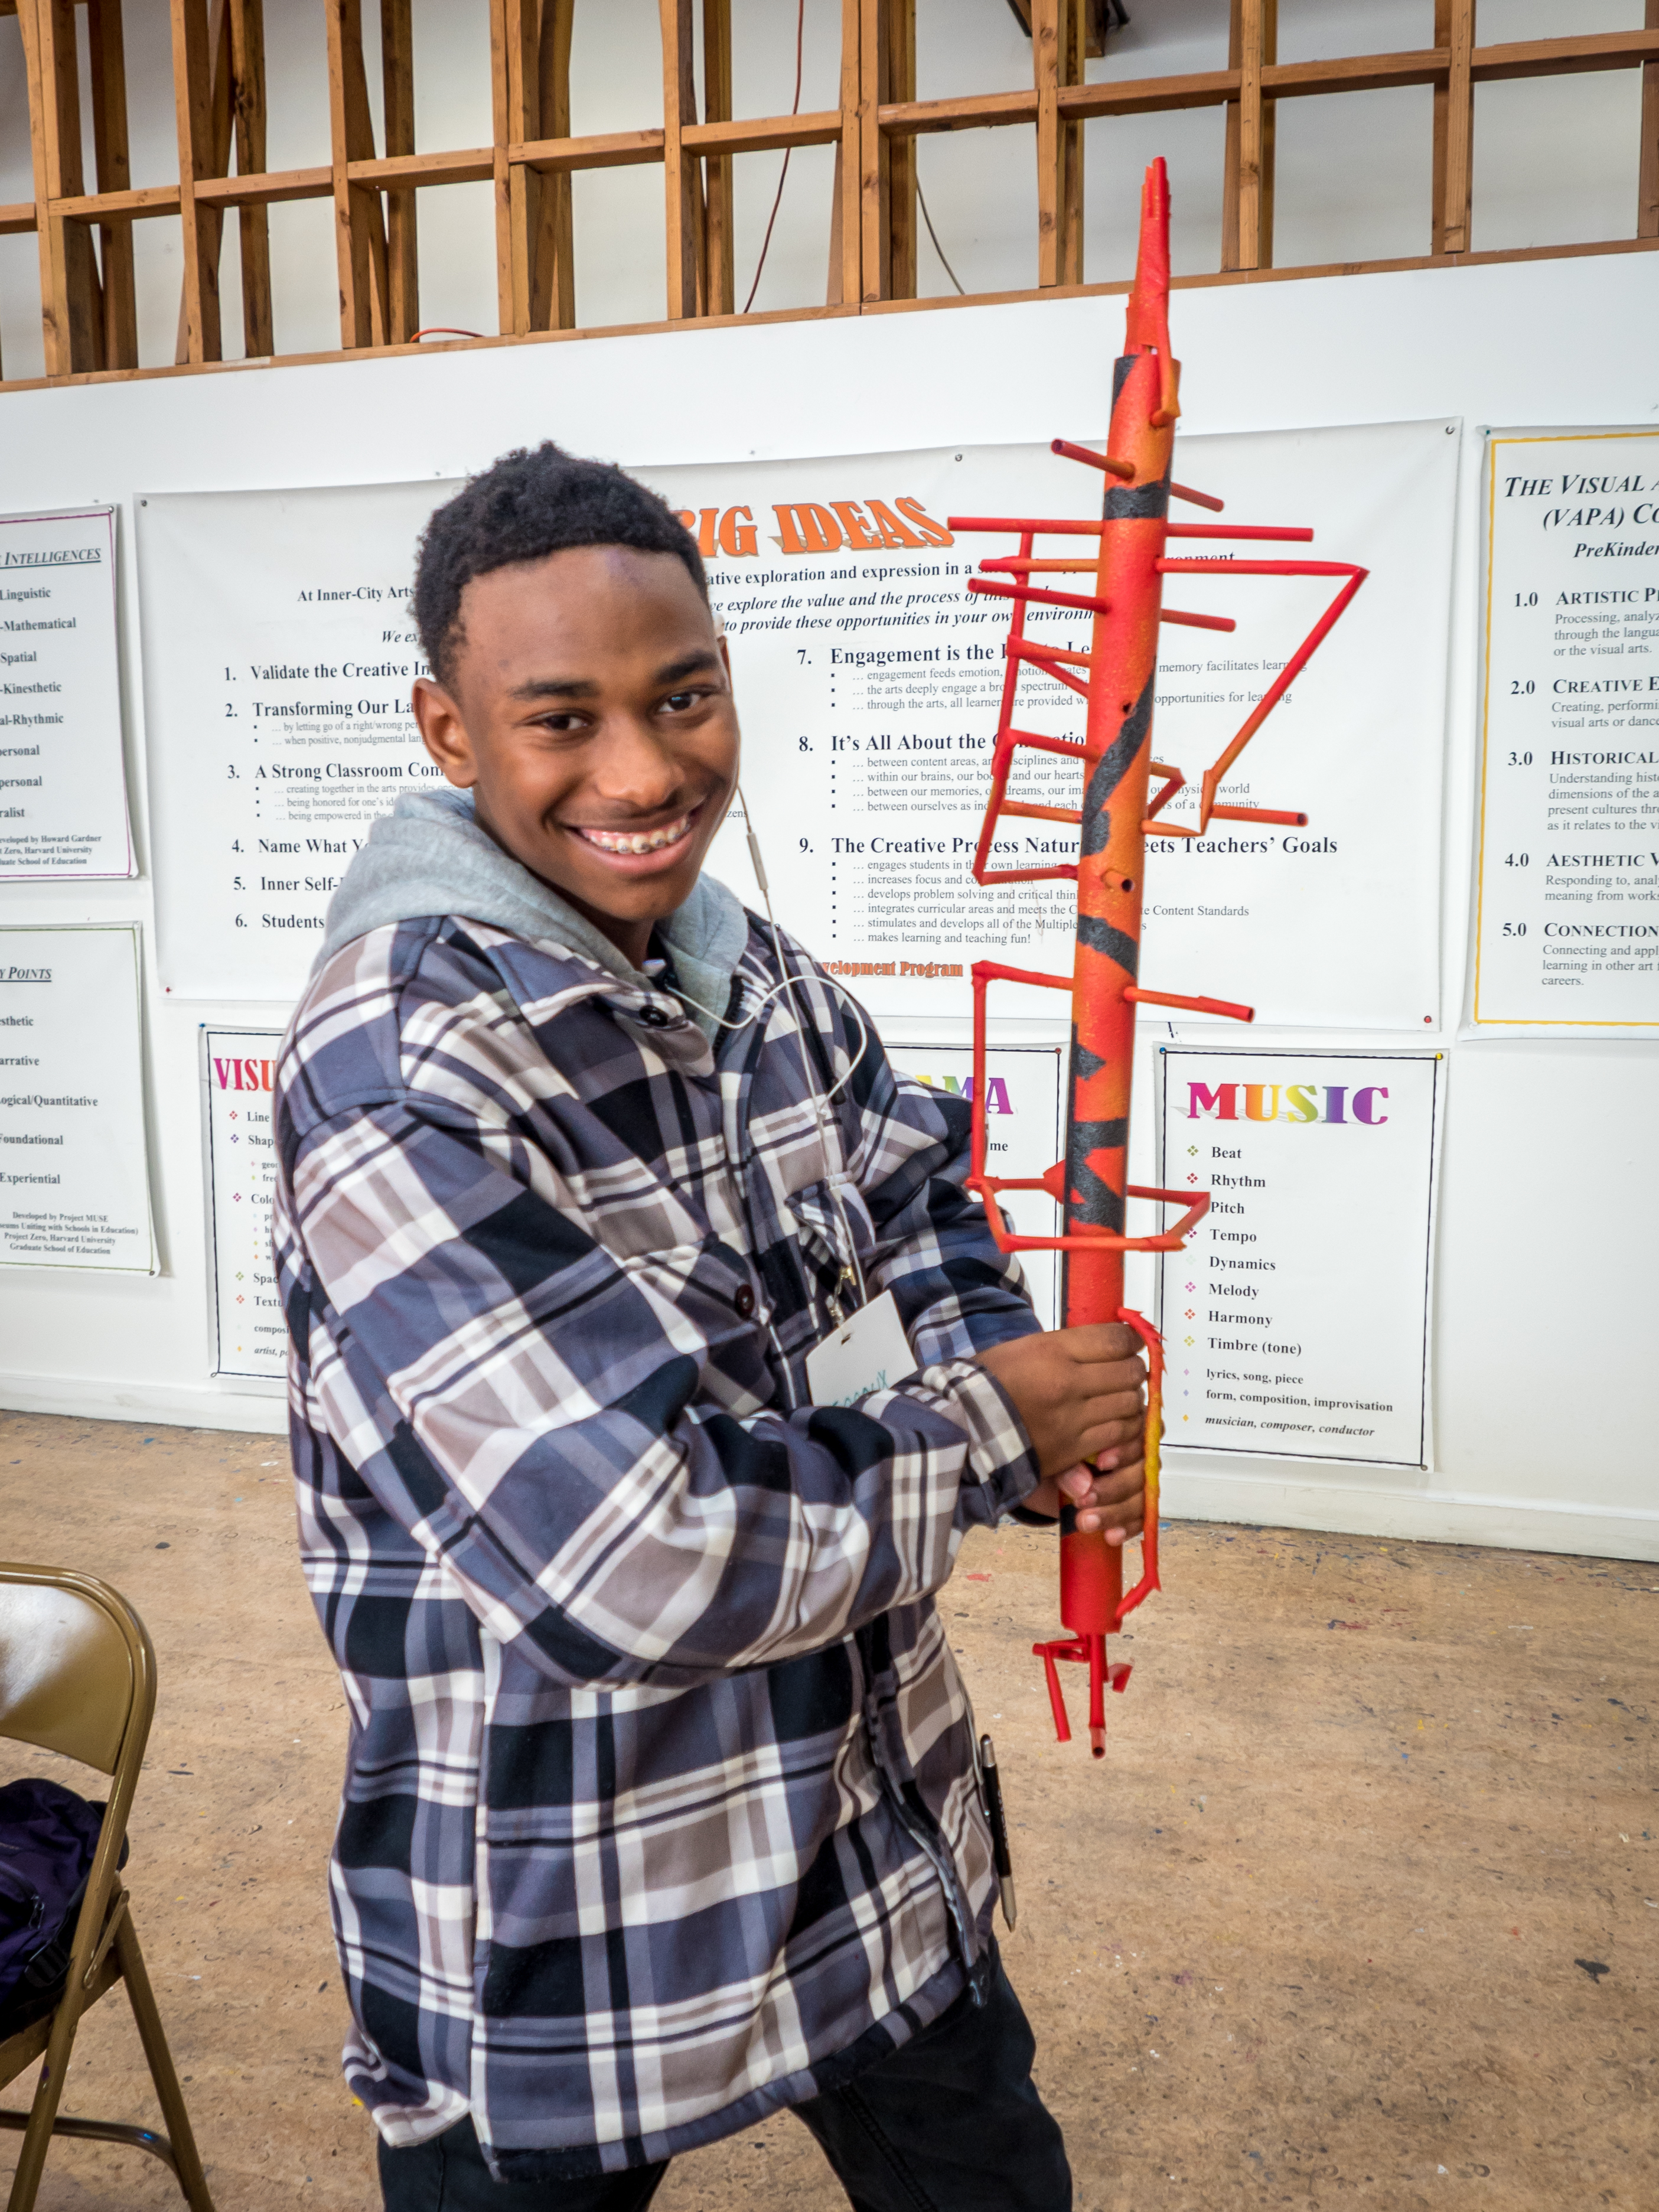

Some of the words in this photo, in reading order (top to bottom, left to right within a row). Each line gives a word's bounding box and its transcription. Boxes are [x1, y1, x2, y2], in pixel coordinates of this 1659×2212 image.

[1505, 477, 1553, 497] THE
[1562, 475, 1644, 494] VISUAL
[772, 497, 955, 553] IDEAS
[1543, 508, 1624, 530] (VAPA)
[5, 548, 101, 565] INTELLIGENCES
[746, 568, 824, 587] exploration
[831, 566, 856, 579] and
[862, 563, 940, 581] expression
[946, 562, 959, 575] in
[965, 565, 972, 574] a
[298, 591, 312, 601] At
[318, 587, 382, 602] Inner-City
[1515, 592, 1538, 607] 1.0
[1556, 591, 1638, 605] ARTISTIC
[728, 597, 777, 614] explore
[781, 595, 802, 608] the
[808, 594, 845, 607] value
[849, 592, 876, 605] and
[881, 592, 902, 605] the
[905, 593, 960, 607] process
[725, 621, 736, 631] to
[739, 616, 791, 634] provide
[796, 615, 832, 628] these
[837, 612, 930, 631] opportunities
[936, 611, 949, 624] in
[952, 614, 987, 627] your
[1555, 612, 1620, 625] Processing,
[1554, 628, 1598, 641] through
[1602, 628, 1620, 638] the
[797, 650, 811, 664] 7.
[831, 647, 940, 667] Engagement
[947, 645, 959, 660] is
[967, 644, 993, 660] the
[1569, 645, 1586, 655] the
[1590, 643, 1624, 654] visual
[1628, 645, 1652, 653] arts.
[225, 667, 236, 680] 1.
[251, 665, 309, 679] Validate
[314, 664, 337, 677] the
[343, 662, 408, 677] Creative
[1159, 664, 1203, 674] memory
[1207, 660, 1259, 671] facilitates
[1511, 680, 1535, 695] 2.0
[1553, 679, 1642, 693] CREATIVE
[226, 703, 237, 716] 2.
[253, 701, 353, 718] Transforming
[358, 700, 389, 714] Our
[1552, 701, 1604, 714] Creating,
[1552, 717, 1585, 728] visual
[1589, 719, 1609, 727] arts
[799, 737, 813, 751] 8.
[866, 735, 890, 750] All
[898, 735, 952, 750] About
[959, 734, 986, 748] the
[1508, 752, 1533, 765] 3.0
[1551, 751, 1658, 765] HISTORICAL
[228, 765, 239, 778] 3.
[256, 765, 266, 778] A
[272, 764, 321, 781] Strong
[326, 764, 402, 777] Classroom
[1550, 773, 1632, 785] Understanding
[1549, 789, 1613, 799] dimensions
[1616, 788, 1631, 798] of
[1632, 788, 1650, 798] the
[1548, 806, 1588, 817] present
[1592, 804, 1637, 814] cultures
[1563, 820, 1570, 830] it
[1574, 820, 1611, 830] relates
[1629, 819, 1647, 829] the
[57, 846, 92, 855] University
[232, 839, 244, 852] 4.
[259, 839, 300, 852] Name
[306, 839, 347, 852] What
[800, 838, 813, 853] 9.
[832, 838, 864, 852] The
[871, 838, 945, 853] Creative
[1283, 837, 1337, 853] Goals
[1505, 853, 1528, 866] 4.0
[1546, 853, 1644, 866] AESTHETIC
[234, 877, 246, 890] 5.
[262, 877, 299, 890] Inner
[1546, 875, 1612, 888] Responding
[1616, 877, 1630, 887] to,
[1545, 890, 1593, 903] meaning
[1597, 890, 1624, 900] from
[1153, 905, 1194, 915] Content
[1198, 906, 1249, 916] Standards
[236, 914, 247, 927] 6.
[262, 914, 324, 928] Students
[1502, 923, 1526, 936] 5.0
[1544, 923, 1658, 937] CONNECTION
[868, 932, 898, 942] makes
[902, 933, 941, 944] learning
[944, 933, 962, 942] and
[966, 933, 1007, 946] teaching
[1011, 934, 1030, 943] fun!
[1543, 944, 1607, 957] Connecting
[1611, 945, 1631, 955] and
[8, 967, 51, 979] POINTS
[900, 961, 963, 978] Program
[1543, 960, 1588, 973] learning
[1592, 960, 1602, 970] in
[1606, 960, 1635, 970] other
[1187, 1082, 1389, 1125] MUSIC
[247, 1112, 269, 1122] Line
[1212, 1146, 1241, 1158] Beat
[0, 1172, 60, 1185] Experiential
[1212, 1174, 1265, 1189] Rhythm
[1211, 1201, 1244, 1214] Pitch
[13, 1211, 47, 1221] Developed
[49, 1213, 57, 1222] by
[60, 1214, 83, 1223] Project
[4, 1232, 28, 1241] Project
[30, 1233, 48, 1242] Zero,
[81, 1236, 116, 1246] University
[1210, 1229, 1256, 1245] Tempo
[1210, 1256, 1275, 1270] Dynamics
[1210, 1283, 1259, 1299] Melody
[1209, 1311, 1272, 1328] Harmony
[1208, 1338, 1257, 1351] Timbre
[1263, 1342, 1301, 1357] (tone)
[1207, 1369, 1240, 1380] lyrics,
[1244, 1374, 1271, 1384] song,
[1276, 1374, 1303, 1384] piece
[1207, 1390, 1236, 1401] form,
[1240, 1395, 1310, 1406] composition,
[1315, 1397, 1393, 1412] improvisation
[1205, 1416, 1256, 1428] musician,
[1261, 1422, 1315, 1432] composer,
[1319, 1425, 1375, 1436] conductor
